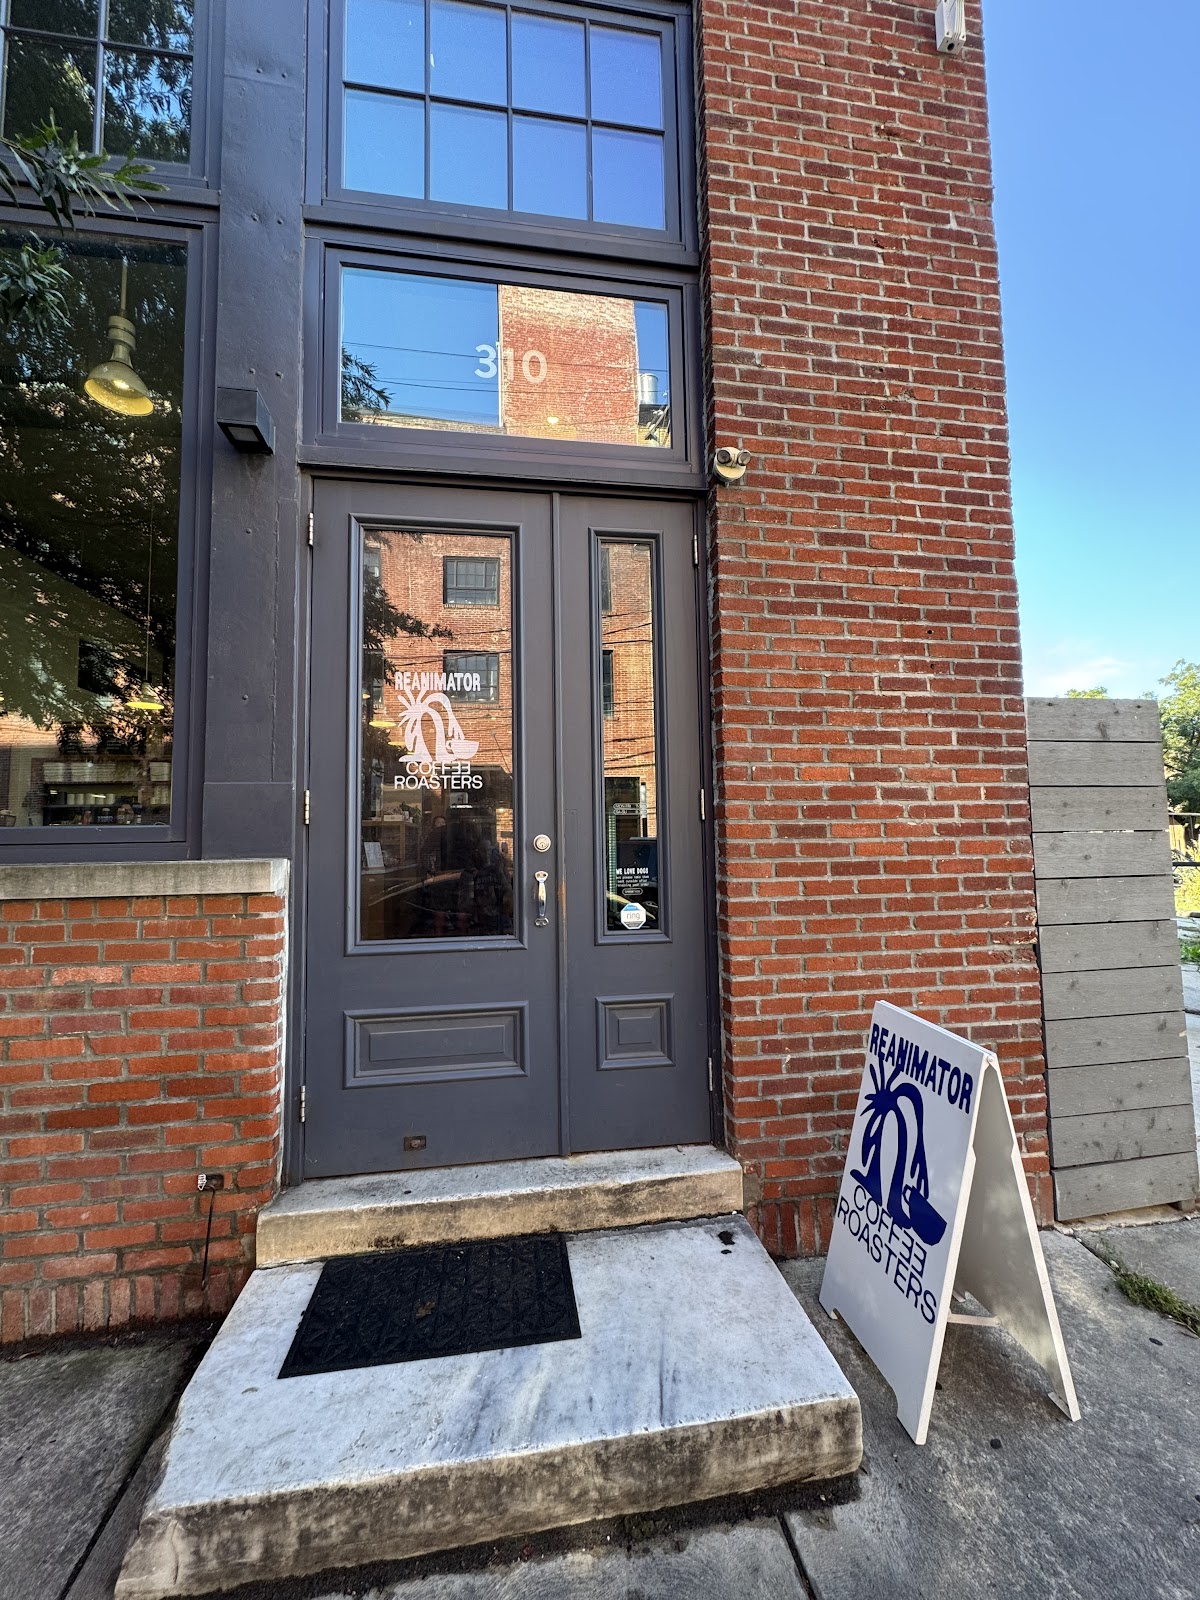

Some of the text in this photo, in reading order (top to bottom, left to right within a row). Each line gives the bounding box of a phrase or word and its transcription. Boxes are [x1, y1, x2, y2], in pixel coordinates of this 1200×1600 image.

[474, 344, 548, 384] 310
[394, 671, 481, 692] REANIMATOR
[394, 775, 483, 790] ROASTERS
[624, 867, 636, 875] LOVE
[626, 911, 641, 921] ring
[869, 1022, 974, 1115] REANIMATOR
[837, 1195, 937, 1325] ROASTERS
